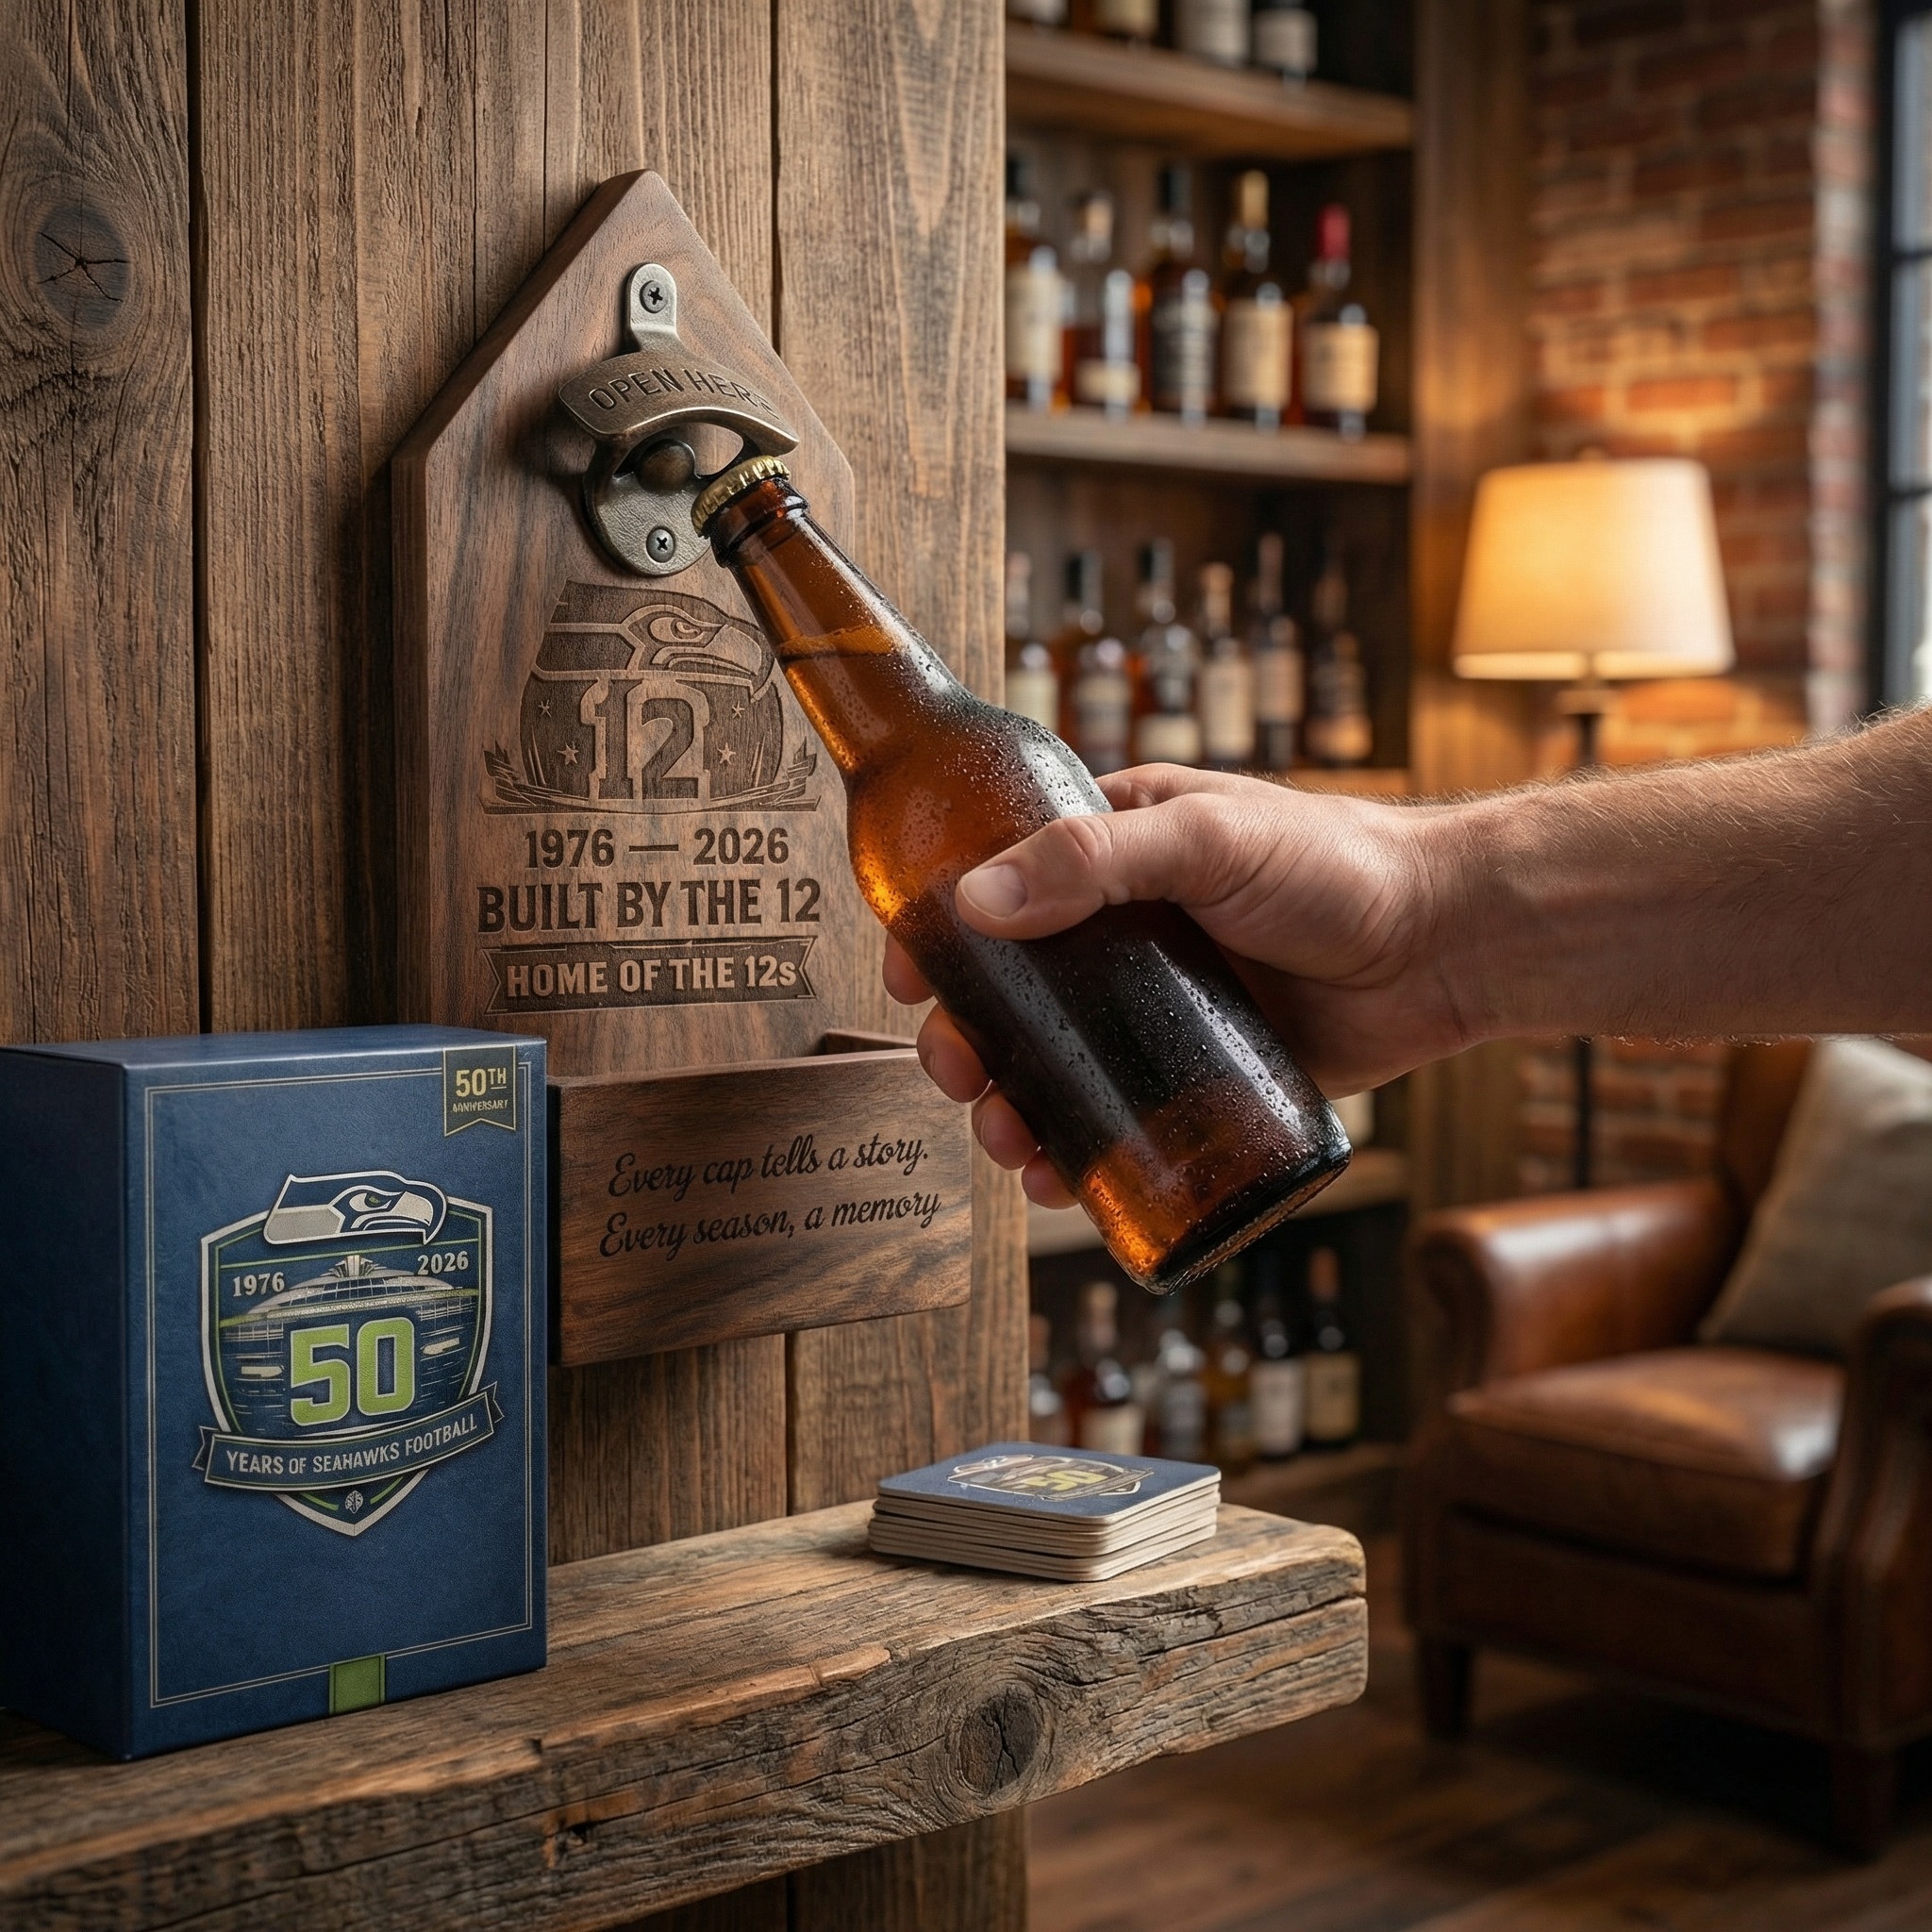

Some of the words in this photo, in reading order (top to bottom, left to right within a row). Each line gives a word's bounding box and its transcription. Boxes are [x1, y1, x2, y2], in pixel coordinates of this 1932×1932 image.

[589, 368, 683, 410] OPEN
[579, 677, 710, 802] 12
[525, 829, 615, 869] 1976
[692, 827, 790, 865] 2026
[477, 883, 604, 934] BUILT
[617, 881, 671, 928] BY
[679, 879, 761, 925] THE
[776, 877, 821, 923] 12
[507, 961, 608, 997] HOME
[619, 959, 662, 991] OF
[668, 957, 736, 991] THE
[744, 956, 797, 987] 12s
[456, 1068, 507, 1097] 50TH
[608, 1152, 698, 1202] Every
[703, 1158, 755, 1193] cap
[760, 1134, 823, 1178] tells
[827, 1146, 849, 1171] a
[853, 1133, 929, 1176] story.
[599, 1212, 689, 1262] Every
[692, 1208, 796, 1245] season,
[804, 1208, 826, 1230] a
[831, 1191, 942, 1229] memory
[232, 1272, 285, 1297] 1976
[417, 1251, 470, 1275] 2026
[290, 1317, 416, 1426] 50
[225, 1449, 284, 1474] YEARS
[288, 1457, 308, 1474] OF
[312, 1446, 400, 1472] SEAHAWKS
[405, 1413, 477, 1456] FOOTBALL
